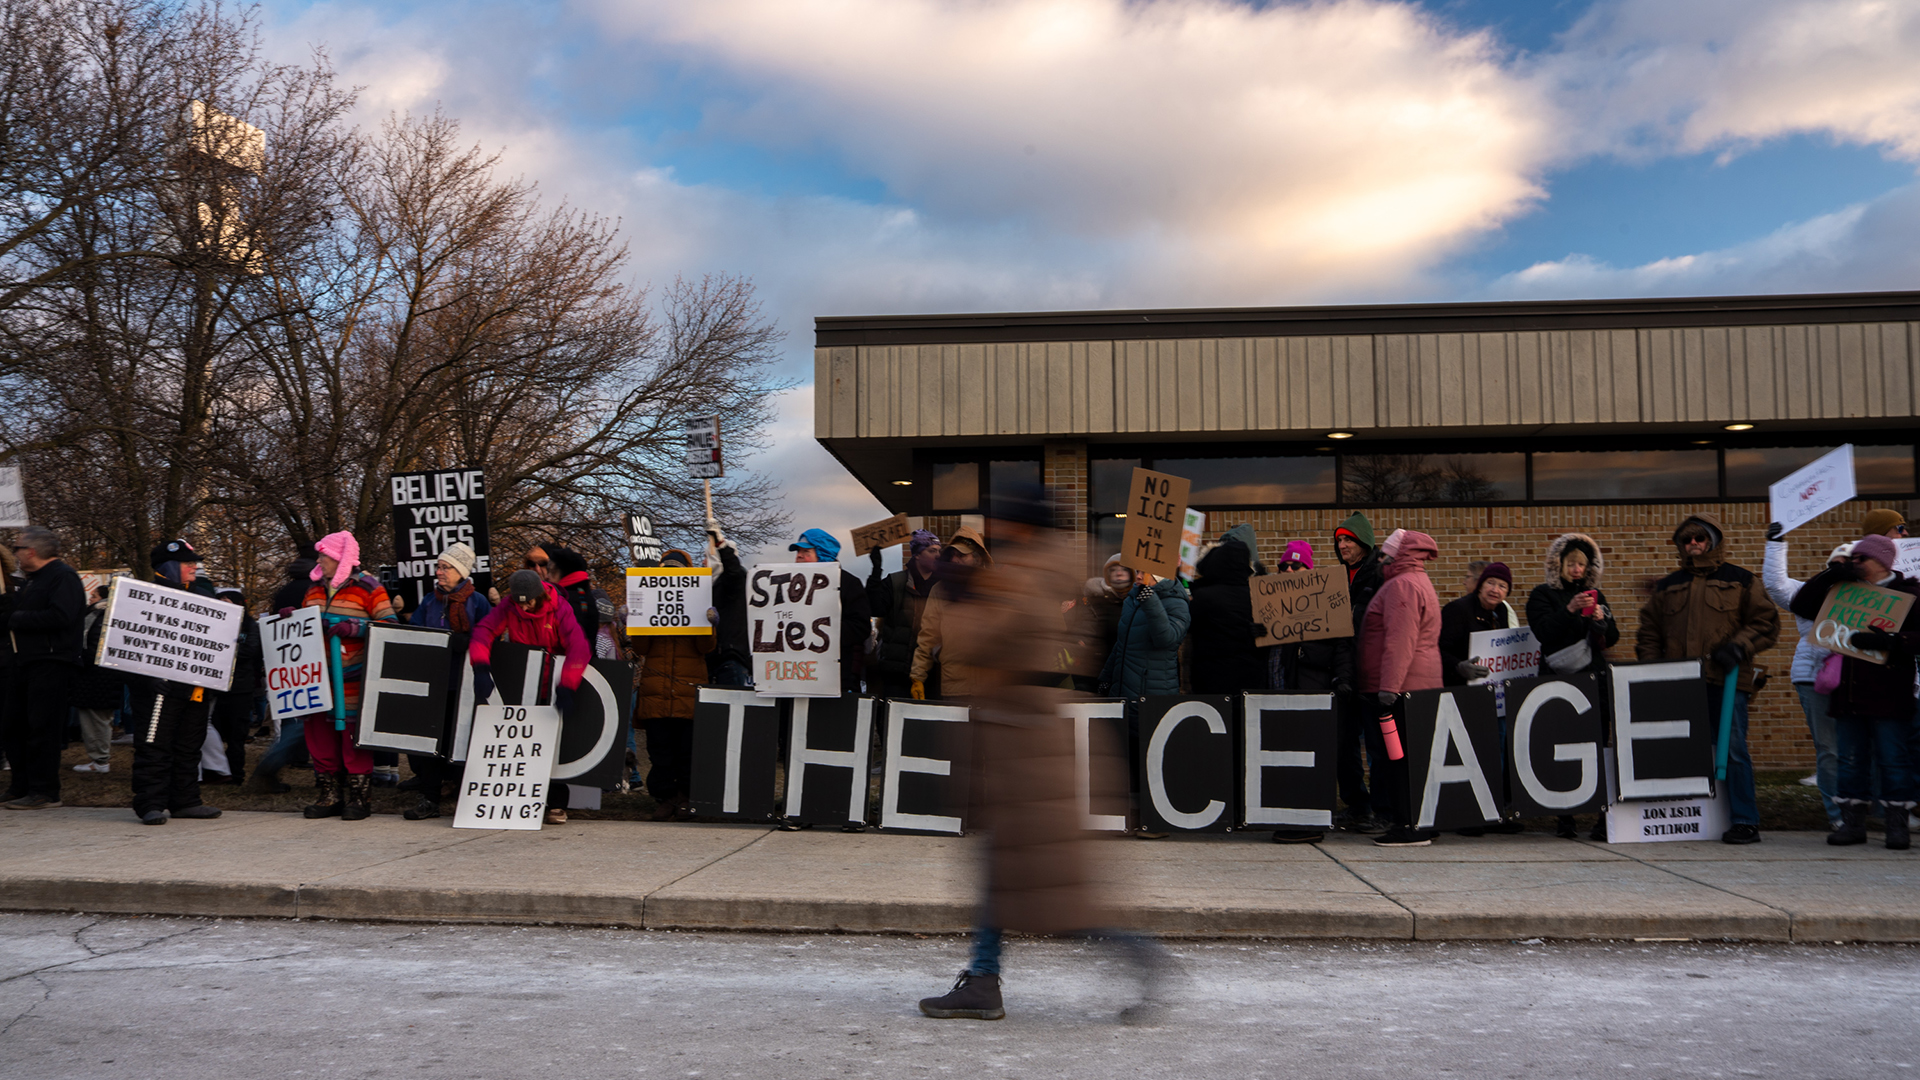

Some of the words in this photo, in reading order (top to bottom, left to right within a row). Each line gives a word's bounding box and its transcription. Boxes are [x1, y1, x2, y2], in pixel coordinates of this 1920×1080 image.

[391, 470, 485, 505] BELIEVE
[1145, 477, 1169, 498] NO
[410, 504, 469, 525] YOUR
[631, 516, 652, 536] NO
[1147, 526, 1162, 539] IN
[409, 524, 475, 557] EYES
[638, 576, 700, 588] ABOLISH
[749, 570, 829, 608] STOP
[128, 588, 156, 604] HEY,
[159, 595, 179, 609] ICE
[180, 601, 227, 620] AGENTS!
[658, 590, 684, 602] ICE
[1281, 592, 1321, 617] NOT
[1835, 582, 1903, 614] RIBBIT
[657, 603, 684, 615] FOR
[775, 611, 793, 619] THE
[1827, 603, 1871, 629] FREE
[110, 618, 178, 640] FOLLOWING
[155, 613, 180, 627] WAS
[181, 620, 210, 634] JUST
[266, 617, 316, 641] TIME
[649, 615, 691, 627] GOOD
[107, 647, 144, 662] WHEN
[145, 654, 174, 668] THIS
[176, 661, 188, 671] IS
[190, 664, 223, 679] OVER!
[161, 643, 191, 658] SAVE
[193, 650, 215, 663] YOU
[276, 643, 302, 664] TO
[268, 661, 322, 690] CRUSH
[277, 686, 324, 714] ICE
[359, 626, 619, 779] END
[699, 687, 971, 833] THE
[1056, 693, 1332, 831] ICE
[1417, 660, 1710, 828] AGE
[494, 725, 533, 739] YOU
[483, 743, 542, 758] HEAR
[487, 762, 526, 777] THE
[467, 782, 542, 797] PEOPLE
[1643, 807, 1667, 819] NOT
[1670, 806, 1702, 817] MUST
[1643, 822, 1699, 836] ROMULUS
